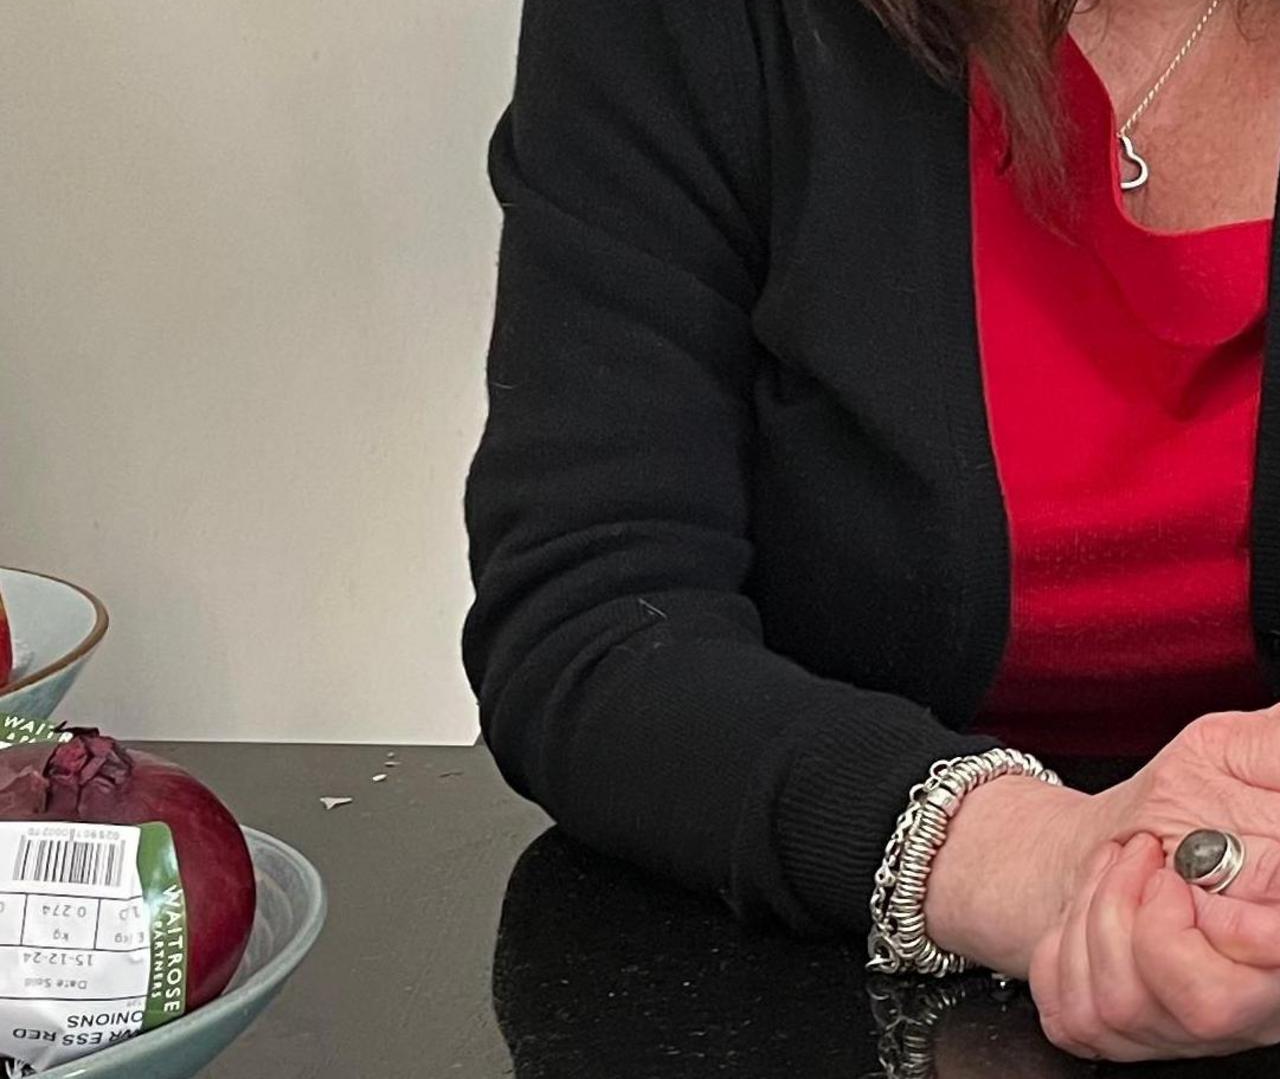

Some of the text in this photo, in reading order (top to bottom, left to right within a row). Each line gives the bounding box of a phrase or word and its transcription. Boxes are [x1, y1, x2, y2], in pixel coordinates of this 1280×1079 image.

[52, 928, 69, 942] kg
[163, 884, 184, 1012] WAITROSE
[23, 951, 95, 967] 15-12-24
[151, 920, 165, 999] PARTNERS
[56, 978, 88, 990] Date
[67, 1009, 144, 1029] ONIONS
[12, 1027, 57, 1043] RED
[62, 1032, 103, 1047] ESS
